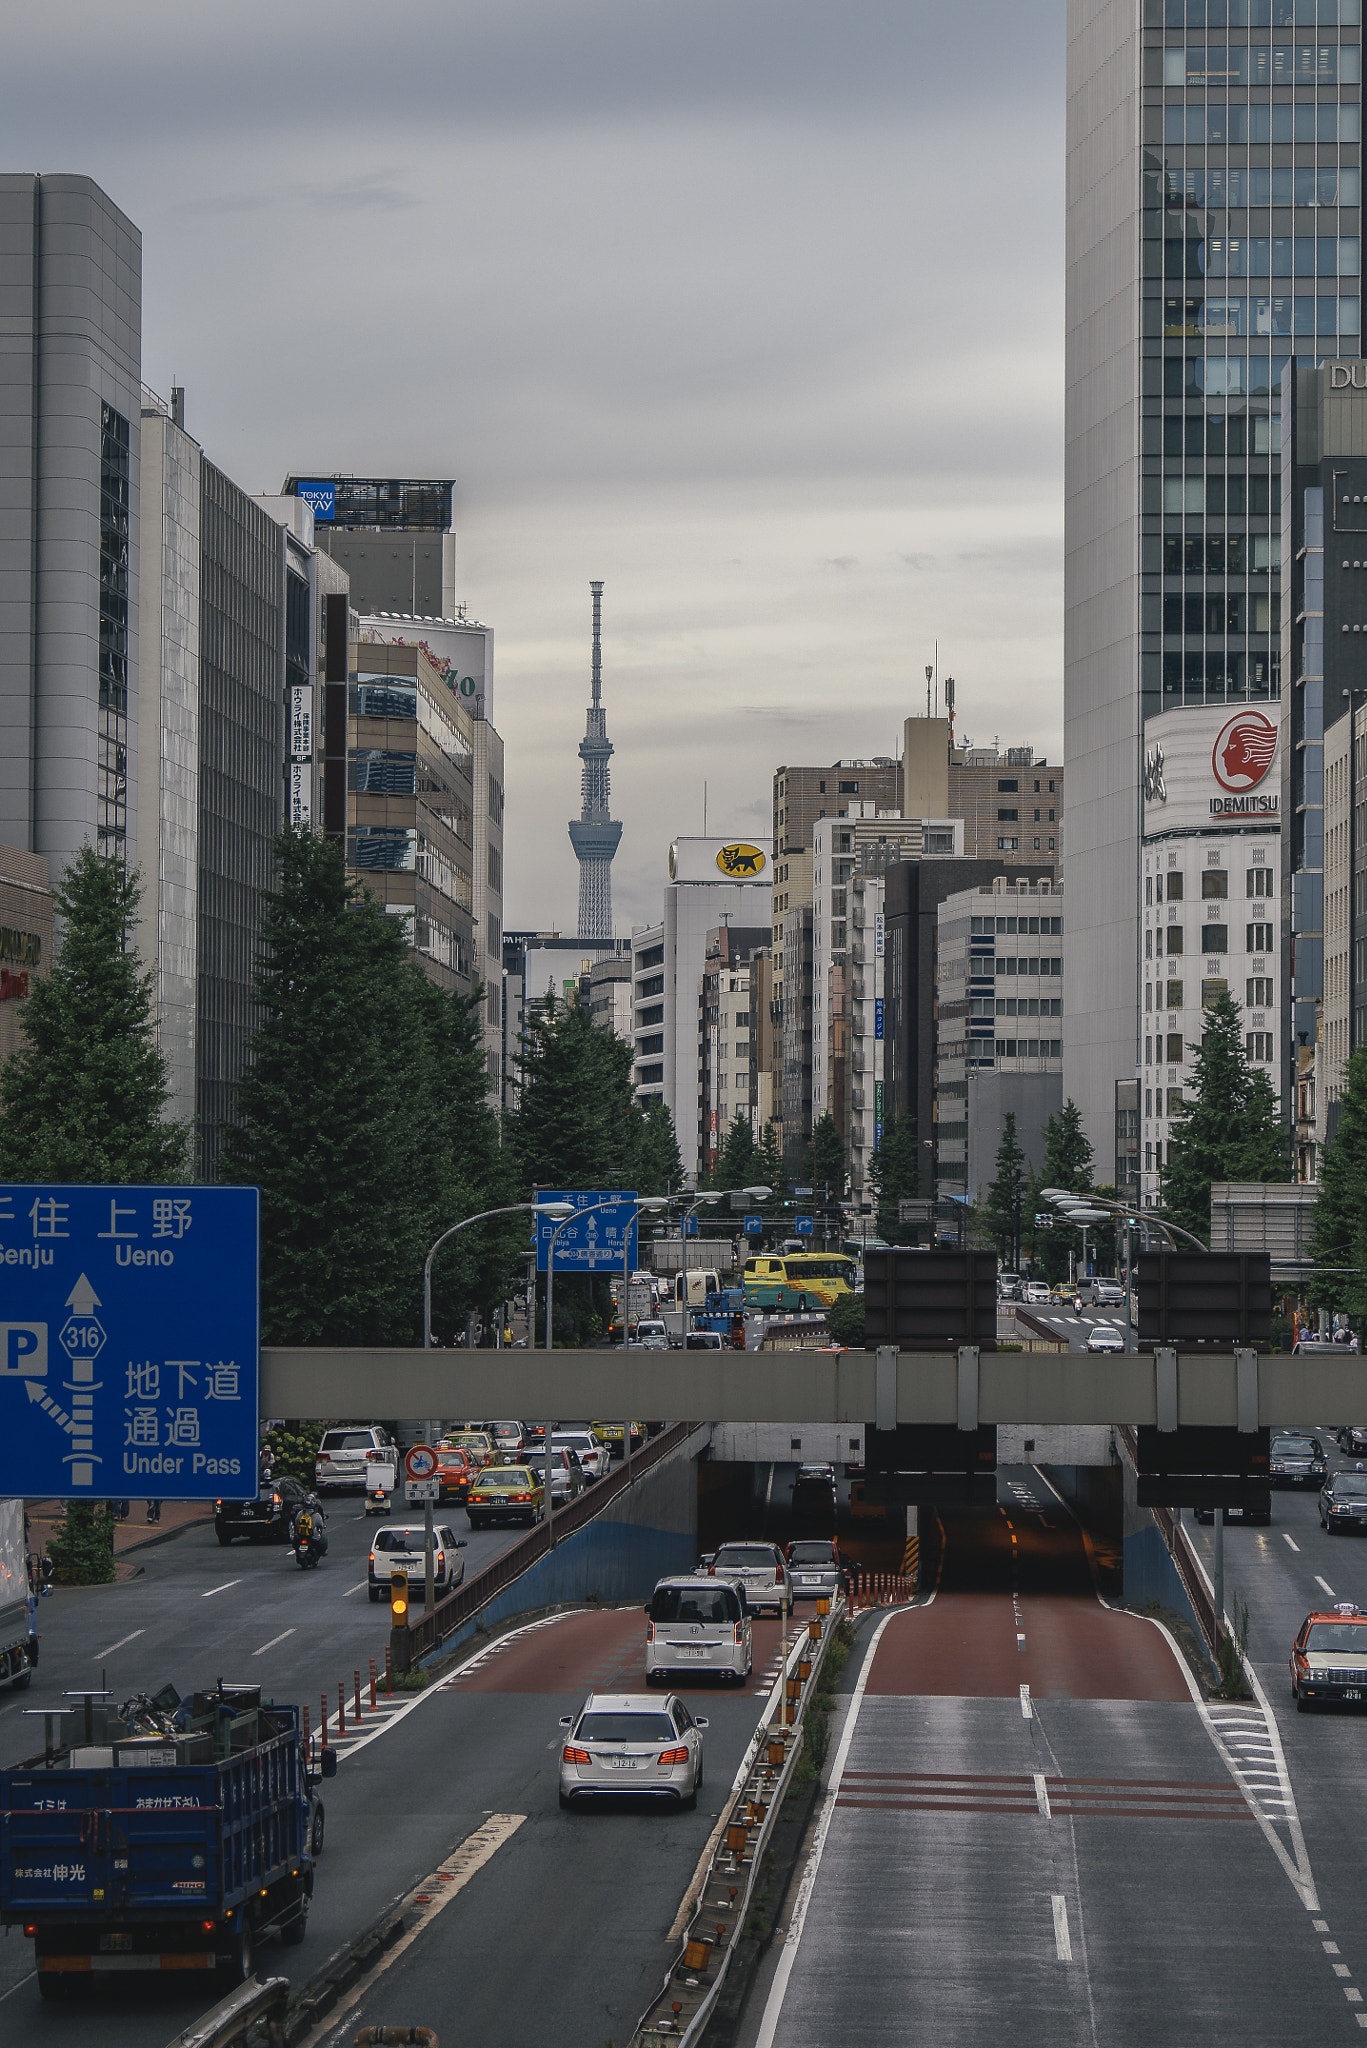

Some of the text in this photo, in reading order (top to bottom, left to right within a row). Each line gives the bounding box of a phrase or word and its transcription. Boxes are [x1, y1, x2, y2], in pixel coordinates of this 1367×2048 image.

[300, 491, 333, 500] TOKYU
[307, 500, 333, 511] TAY
[293, 687, 303, 752] ホウライ株式会社
[1209, 795, 1279, 813] IDEMITSU
[502, 936, 514, 944] PA
[562, 1194, 589, 1207] 千住
[97, 1198, 193, 1239] 上野
[115, 1244, 175, 1267] Ueno
[66, 1326, 100, 1349] 316
[7, 1329, 39, 1370] P
[124, 1360, 242, 1401] 地下道
[123, 1406, 201, 1447] 通過
[123, 1452, 241, 1475] Under Pass
[135, 1796, 200, 1809] おまかせ下さい
[176, 1881, 205, 1889] HINO
